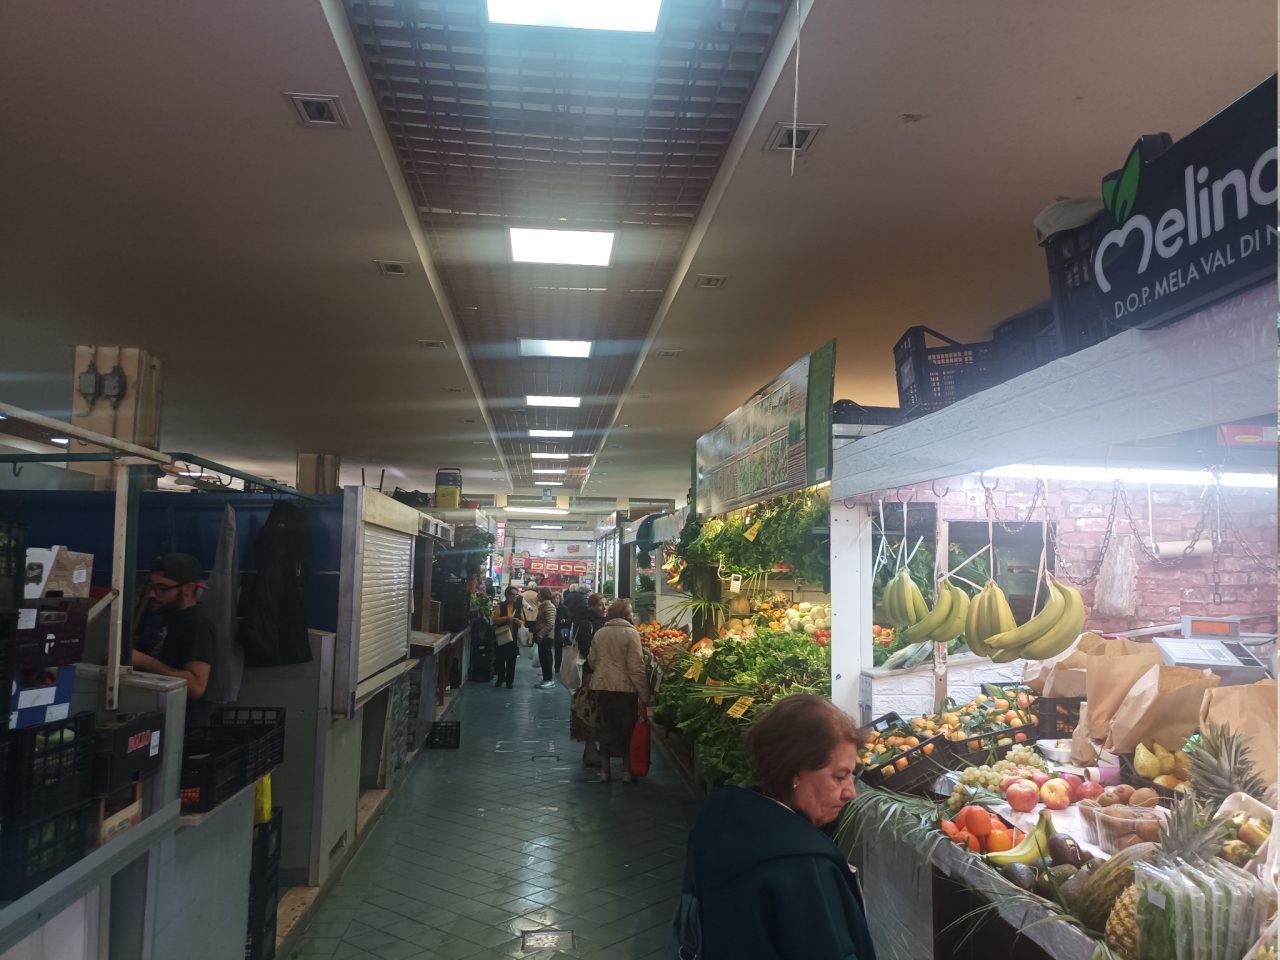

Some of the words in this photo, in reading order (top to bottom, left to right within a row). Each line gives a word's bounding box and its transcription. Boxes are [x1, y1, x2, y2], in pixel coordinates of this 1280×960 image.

[1115, 287, 1151, 319] D.O.P.
[1154, 262, 1200, 300] MELA
[1200, 243, 1235, 275] VAL
[1240, 229, 1260, 258] DI
